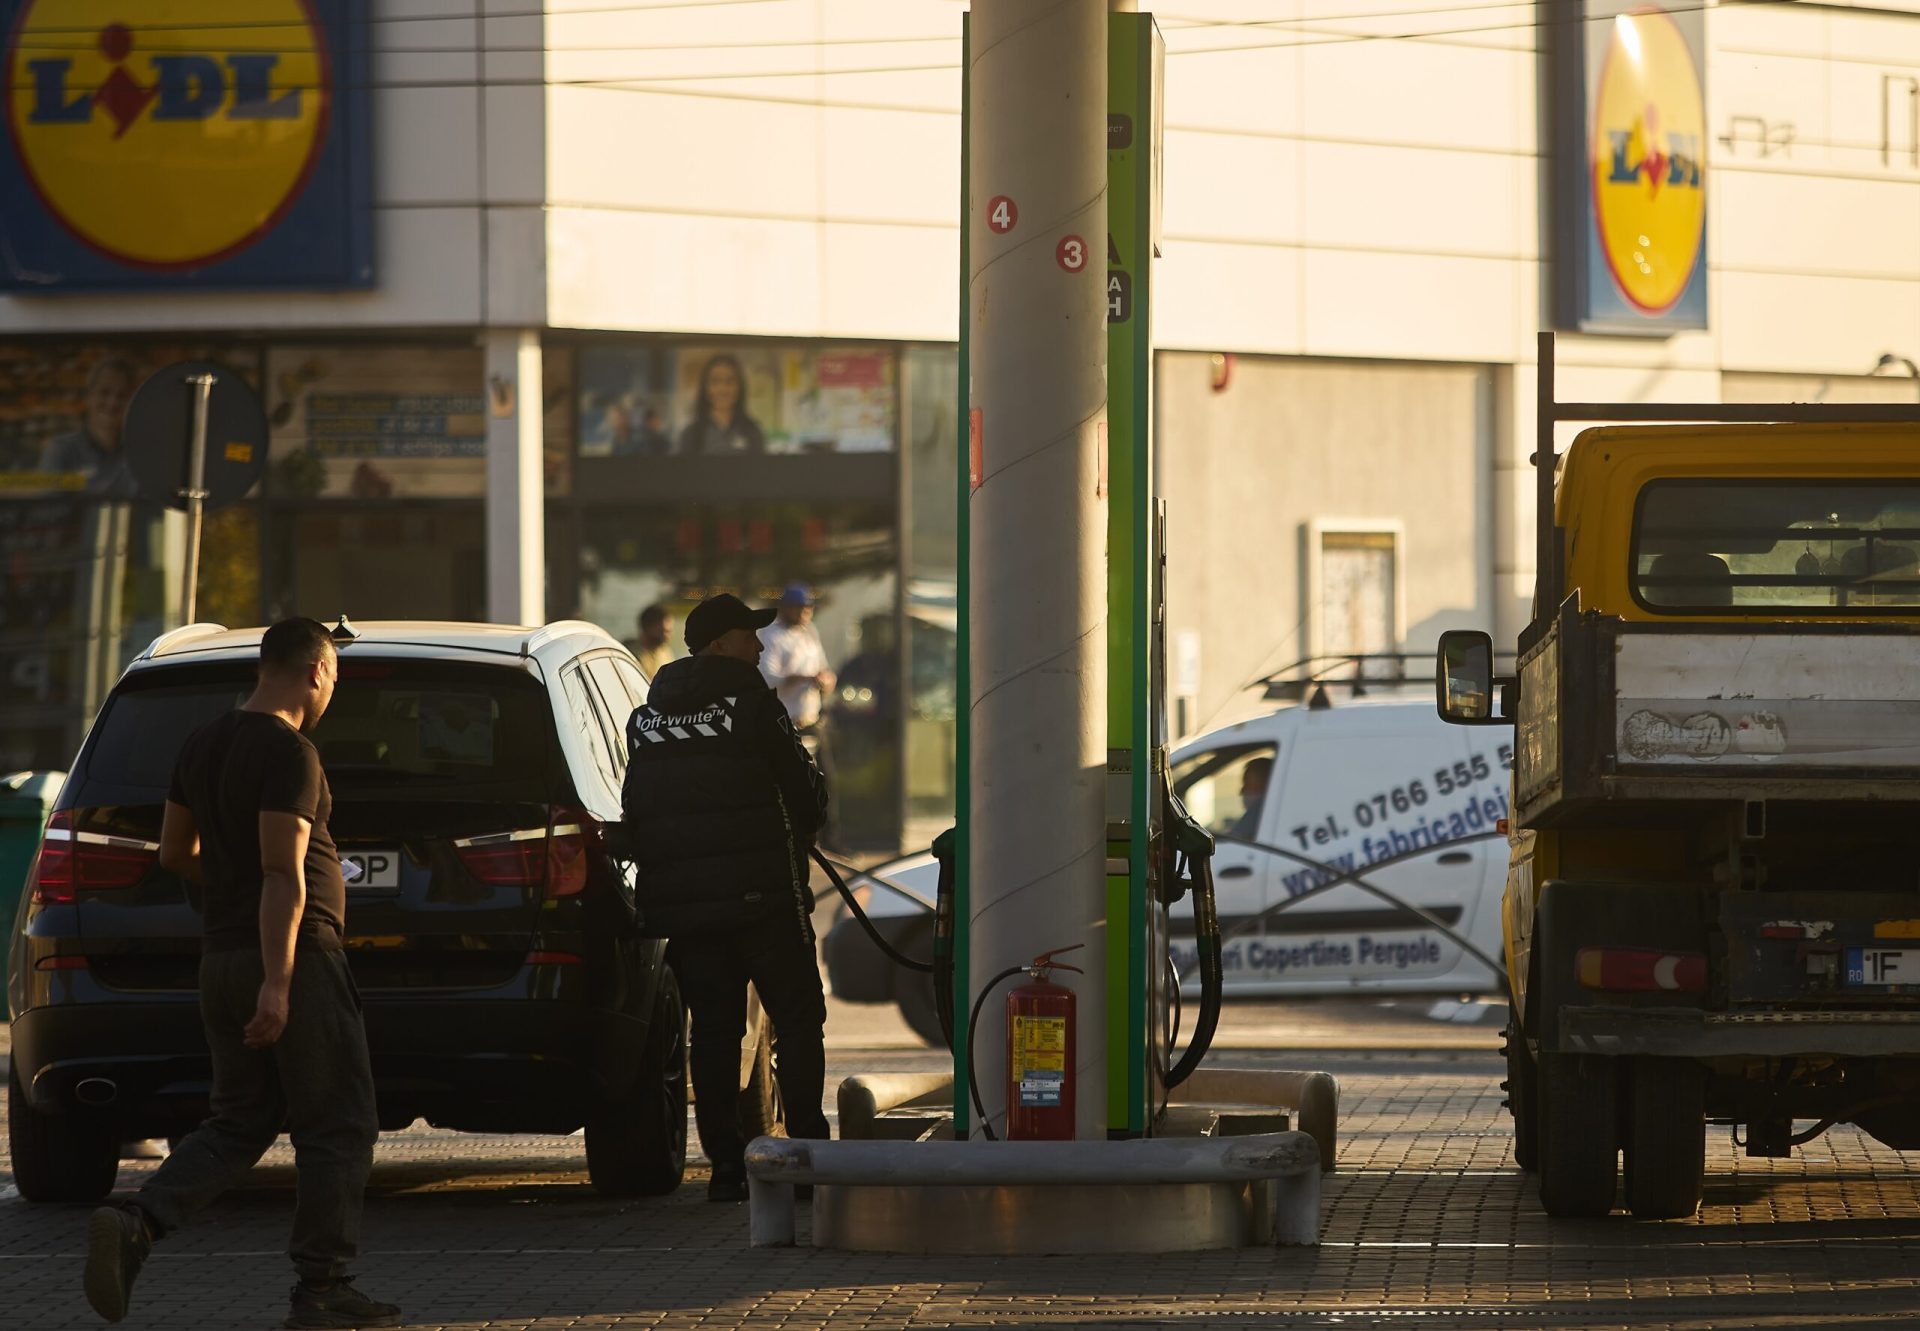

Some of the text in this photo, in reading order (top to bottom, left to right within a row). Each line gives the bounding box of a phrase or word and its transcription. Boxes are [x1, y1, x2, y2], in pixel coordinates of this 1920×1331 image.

[991, 201, 1011, 229] 4
[1063, 241, 1083, 269] 3
[1291, 814, 1349, 851] Tel.
[1354, 780, 1428, 828] 0766
[1434, 753, 1490, 796] 555
[1357, 935, 1441, 969] Pergole
[1848, 969, 1862, 982] RO
[1872, 952, 1902, 982] IF
